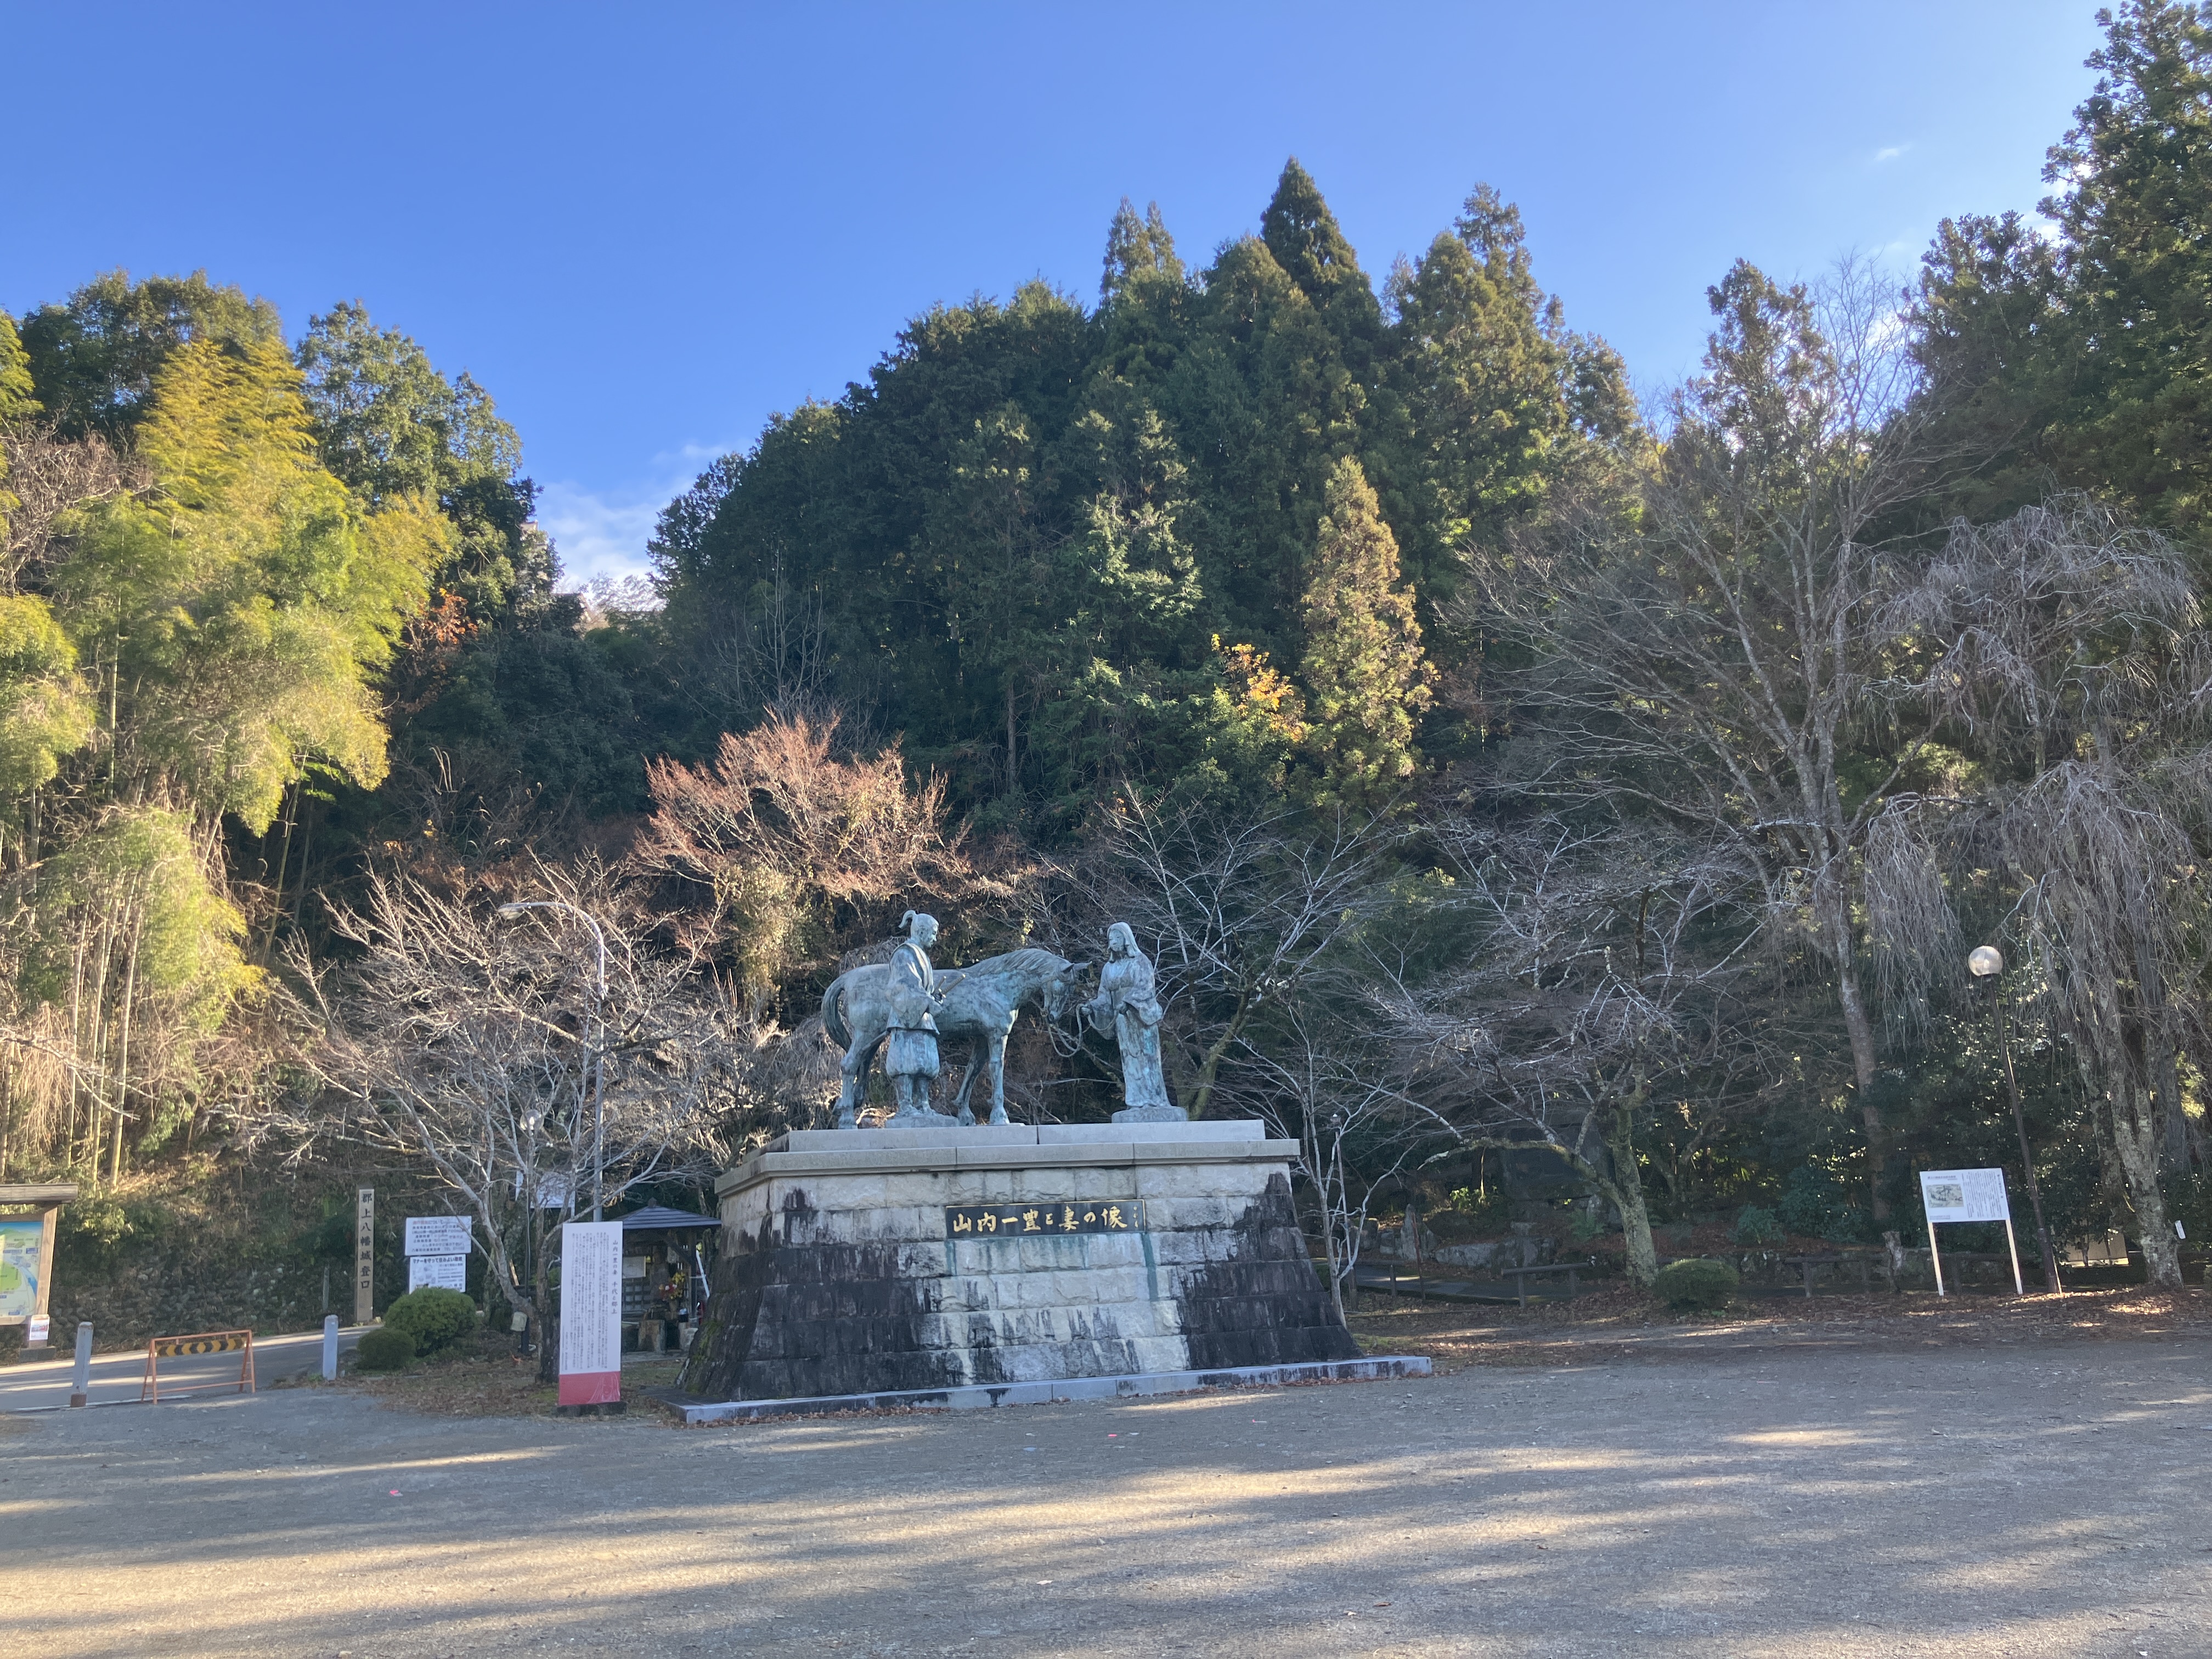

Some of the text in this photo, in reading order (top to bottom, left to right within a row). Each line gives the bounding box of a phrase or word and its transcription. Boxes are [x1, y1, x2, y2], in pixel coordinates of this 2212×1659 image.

[360, 1193, 373, 1289] 郡上八幡城登口
